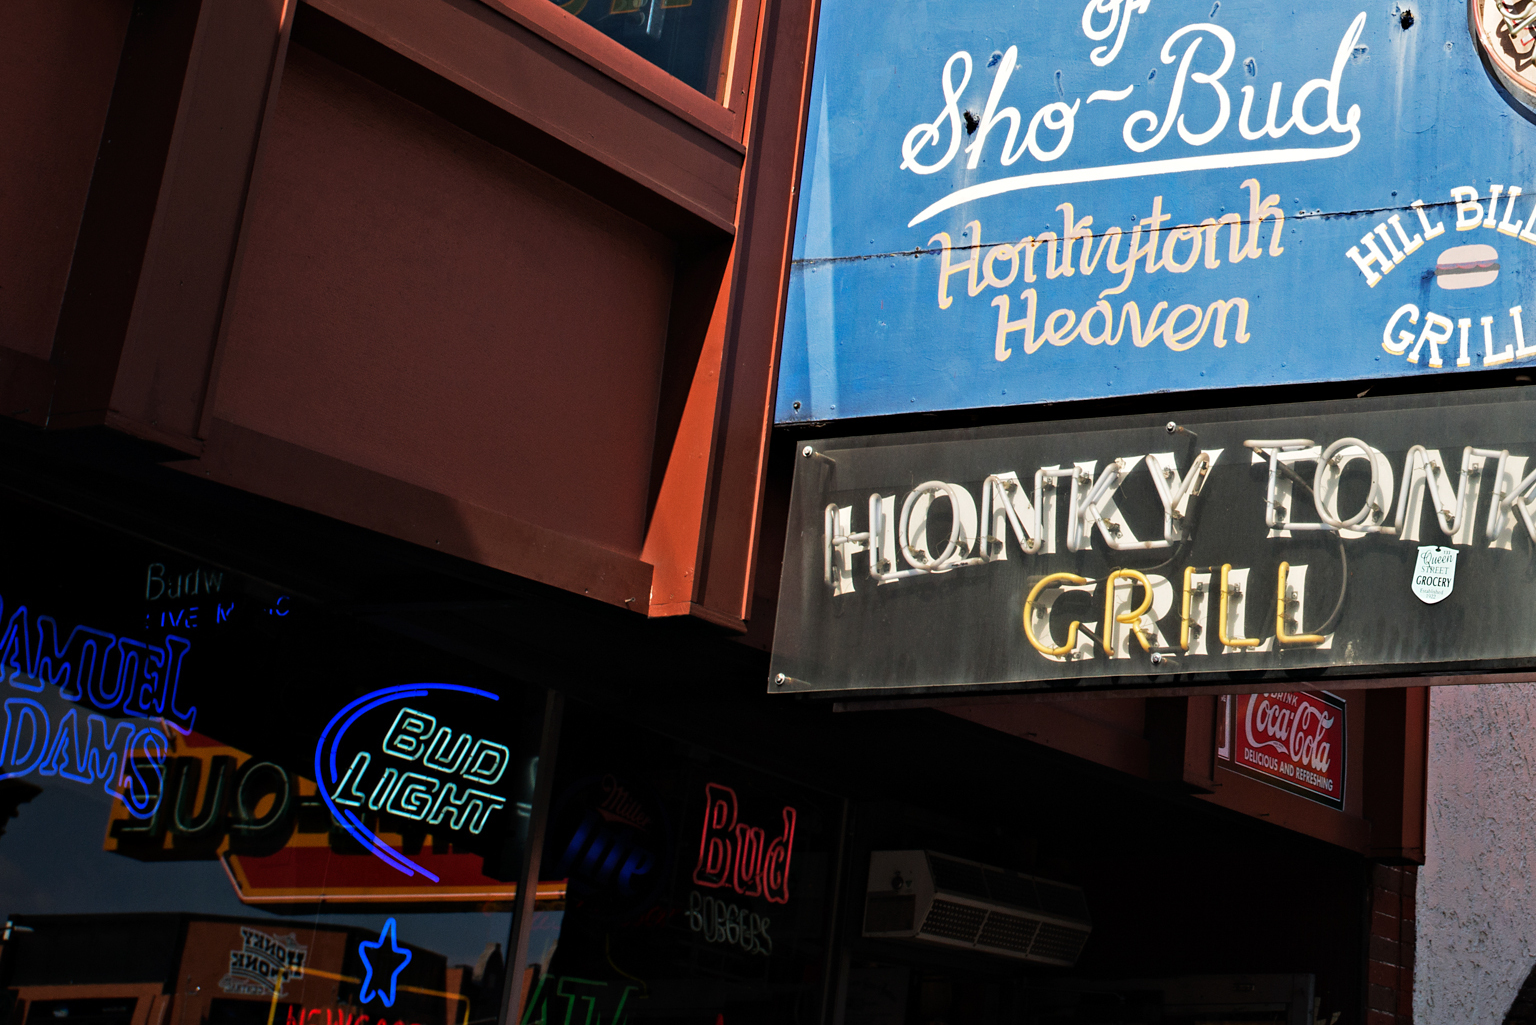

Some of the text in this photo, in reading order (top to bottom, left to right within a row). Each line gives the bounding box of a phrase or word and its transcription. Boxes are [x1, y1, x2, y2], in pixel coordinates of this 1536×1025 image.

[929, 178, 1285, 310] Honkytonk
[1346, 200, 1444, 288] HILL
[992, 288, 1251, 363] Heaven
[824, 448, 1226, 595] HONKY
[1420, 549, 1455, 569] Queen
[1416, 575, 1452, 588] GROCERY
[1421, 565, 1450, 575] STREET
[1023, 560, 1335, 662] GRILL
[1266, 691, 1299, 707] DRINK
[383, 707, 510, 786] BUD
[1244, 747, 1334, 792] DELICIOUS AND REFRESHING
[331, 751, 507, 835] LIGHT
[692, 781, 798, 905] Bud
